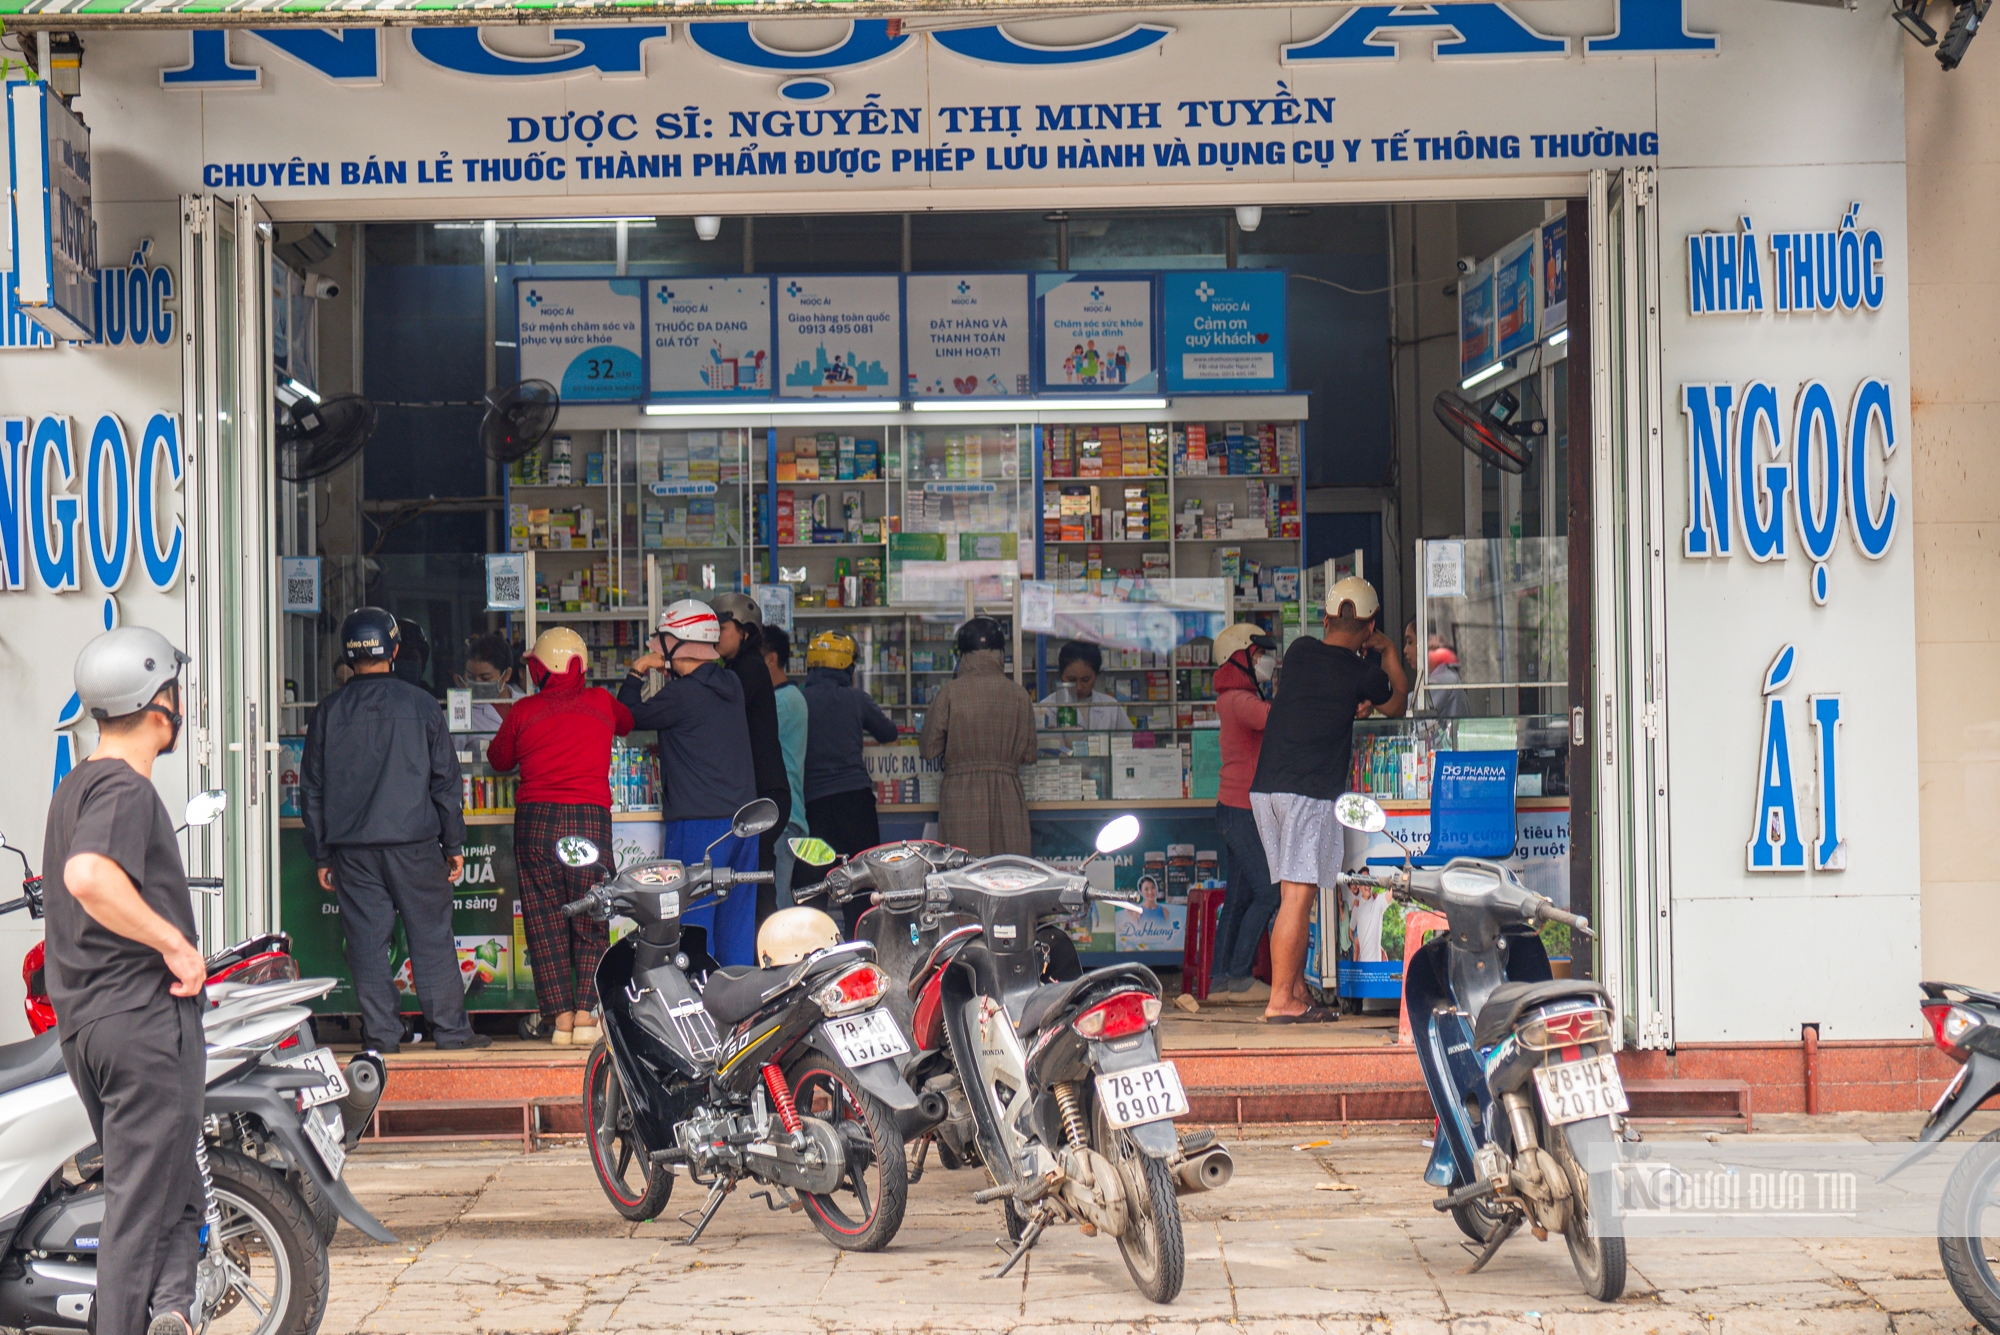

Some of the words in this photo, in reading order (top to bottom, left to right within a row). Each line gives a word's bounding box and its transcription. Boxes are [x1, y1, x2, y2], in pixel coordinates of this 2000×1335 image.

[507, 111, 638, 149] DƯỢC
[655, 105, 713, 141] SĨ:
[729, 93, 922, 138] NGUYỄN
[938, 106, 1022, 138] THỊ
[1036, 102, 1162, 131] MINH
[1178, 80, 1336, 128] TUYỀN
[203, 157, 330, 188] CHUYÊN
[340, 153, 407, 185] BÁN
[417, 151, 453, 184] LẺ
[462, 150, 566, 182] THUỐC
[575, 151, 682, 180] THÀNH
[693, 144, 787, 178] PHẨM
[794, 147, 881, 178] ĐƯỢC
[891, 143, 975, 173] PHÉP
[986, 145, 1048, 171] LƯU
[1057, 140, 1145, 169] HÀNH
[1153, 137, 1191, 168] VÀ
[1198, 141, 1286, 172] DỤNG
[1292, 140, 1335, 169] CỤ
[1343, 139, 1361, 163] Y
[1371, 129, 1409, 162] TẾ
[1413, 130, 1521, 161] THÔNG
[1530, 127, 1659, 159] THƯỜNG
[1690, 215, 1764, 314] NHÀ
[1772, 202, 1885, 312] THUỐC
[672, 305, 694, 315] NGỌC
[697, 304, 708, 313] ÁI
[800, 299, 821, 307] NGỌC
[1211, 303, 1239, 313] NGỌC
[1240, 301, 1250, 311] ÁI
[540, 308, 563, 317] NGỌC
[788, 313, 811, 322] Giao
[813, 312, 839, 324] hàng
[841, 312, 864, 322] toàn
[866, 311, 891, 324] quốc
[521, 321, 536, 332] Sứ
[539, 321, 568, 333] mệnh
[571, 321, 600, 332] chăm
[602, 321, 620, 331] sóc
[622, 321, 635, 331] và
[655, 319, 694, 332] THUỐC
[715, 321, 748, 333] DẠNG
[798, 324, 827, 334] 0913
[829, 324, 852, 334] 495
[854, 324, 874, 334] 081
[930, 320, 953, 333] ĐẶT
[956, 317, 989, 329] HÀNG
[992, 317, 1008, 329] VÀ
[1053, 319, 1082, 329] Chăm
[1083, 318, 1100, 329] sóc
[1101, 318, 1118, 329] sức
[1120, 318, 1144, 329] khỏe
[1193, 315, 1226, 330] Cảm
[1228, 317, 1248, 330] ơn
[521, 335, 547, 347] phục
[550, 336, 562, 346] vụ
[564, 333, 584, 344] sức
[587, 332, 612, 344] khỏe
[655, 335, 676, 347] GIÁ
[678, 333, 700, 347] TỐT
[930, 333, 970, 344] THANH
[973, 331, 1006, 343] TOÁN
[1072, 328, 1083, 337] cả
[1085, 328, 1103, 339] gia
[1104, 327, 1124, 337] đình
[1185, 331, 1212, 348] quý
[1213, 331, 1256, 345] khách
[935, 347, 963, 358] LINH
[965, 347, 1001, 359] HOẠT!
[587, 359, 614, 379] 32
[1685, 381, 1899, 602] NGỌC
[1750, 644, 1847, 869] ÁI
[877, 752, 899, 778] VỰC
[901, 755, 916, 773] RA
[1463, 765, 1506, 776] PHARMA
[1523, 825, 1553, 839] tiêu
[469, 845, 496, 857] PHÁP
[1533, 843, 1566, 860] ruột
[466, 896, 498, 912] sàng
[1113, 1039, 1139, 1050] HONDA
[1447, 1041, 1471, 1055] HONDA
[1109, 1069, 1165, 1100] 78-P1
[1116, 1091, 1176, 1123] 8902
